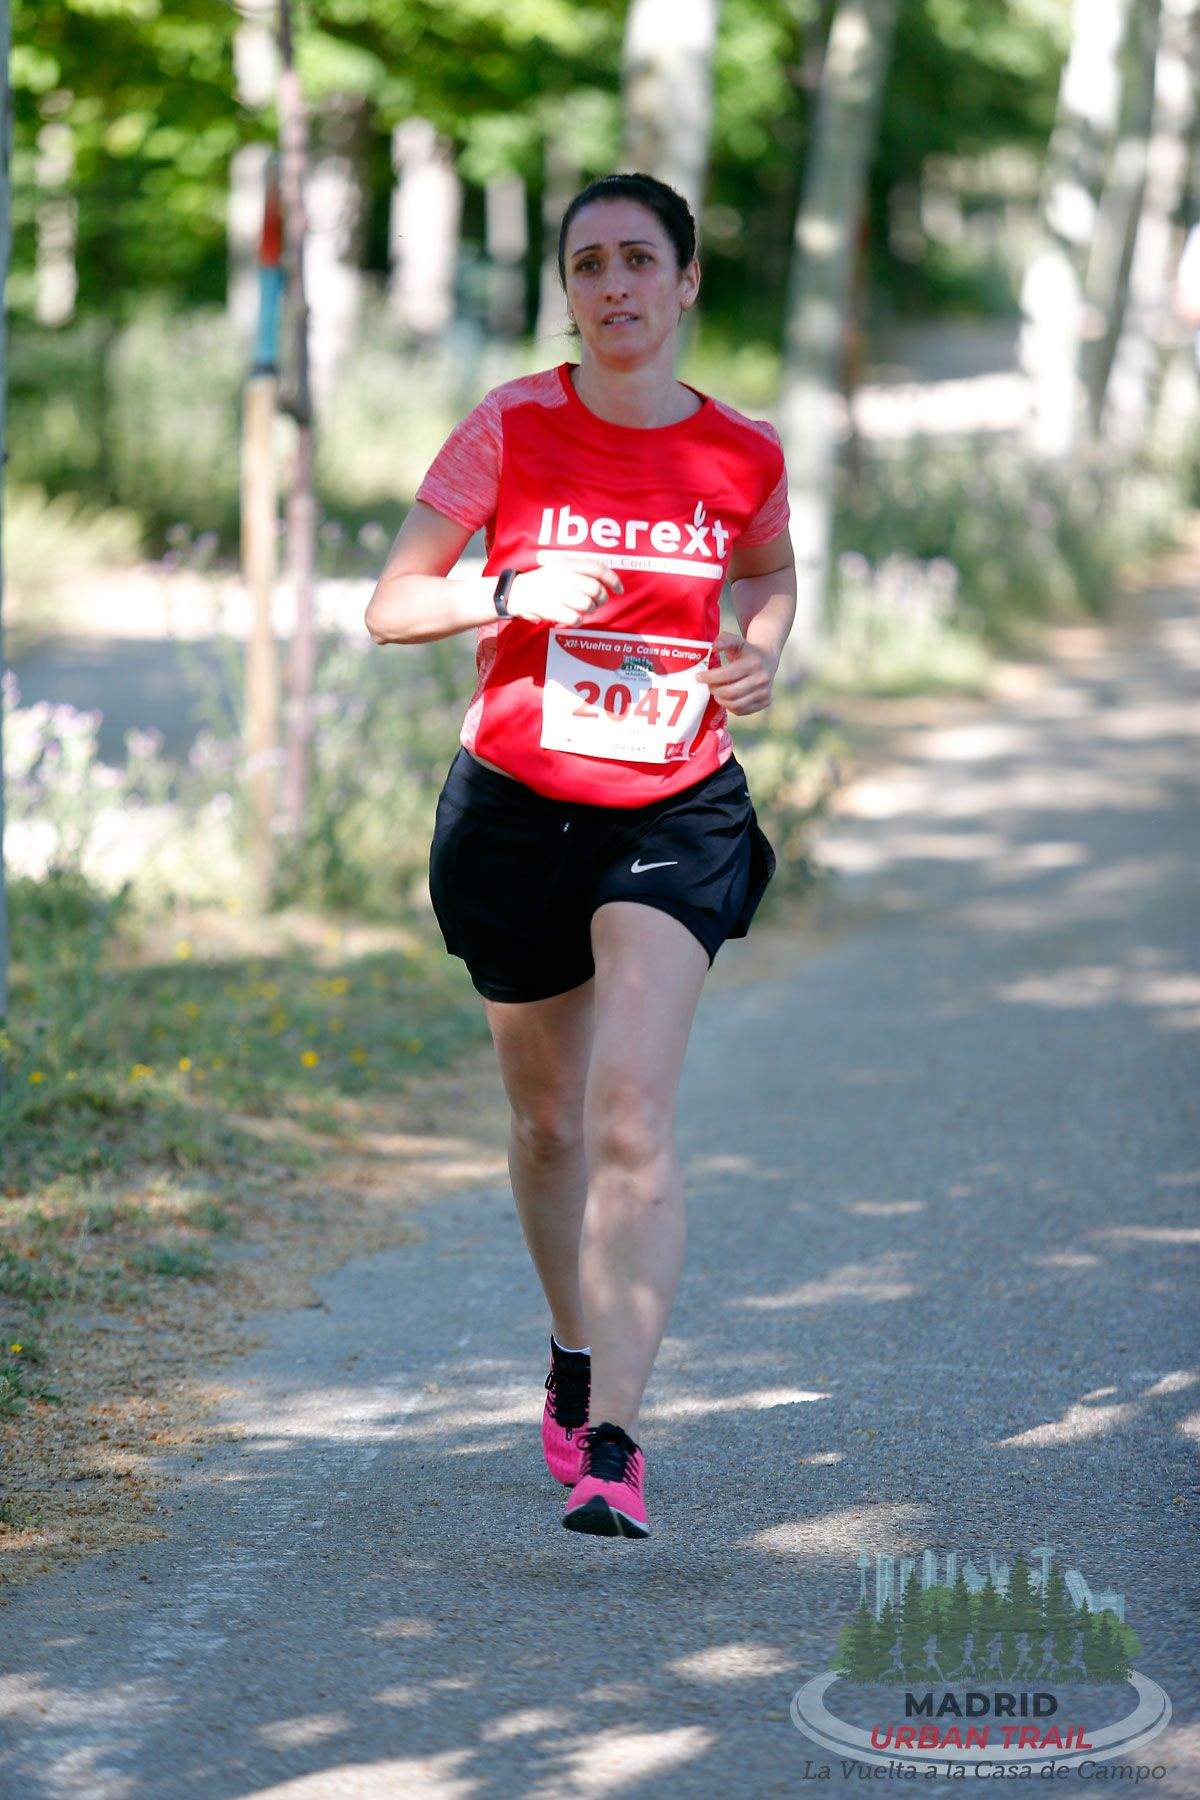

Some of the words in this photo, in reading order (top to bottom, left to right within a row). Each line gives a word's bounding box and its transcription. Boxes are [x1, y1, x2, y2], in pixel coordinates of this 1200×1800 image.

[537, 501, 729, 559] Iberext
[613, 644, 620, 652] a
[637, 645, 660, 655] Casa
[660, 647, 671, 657] de
[671, 649, 702, 661] Campo
[572, 680, 689, 727] 2047
